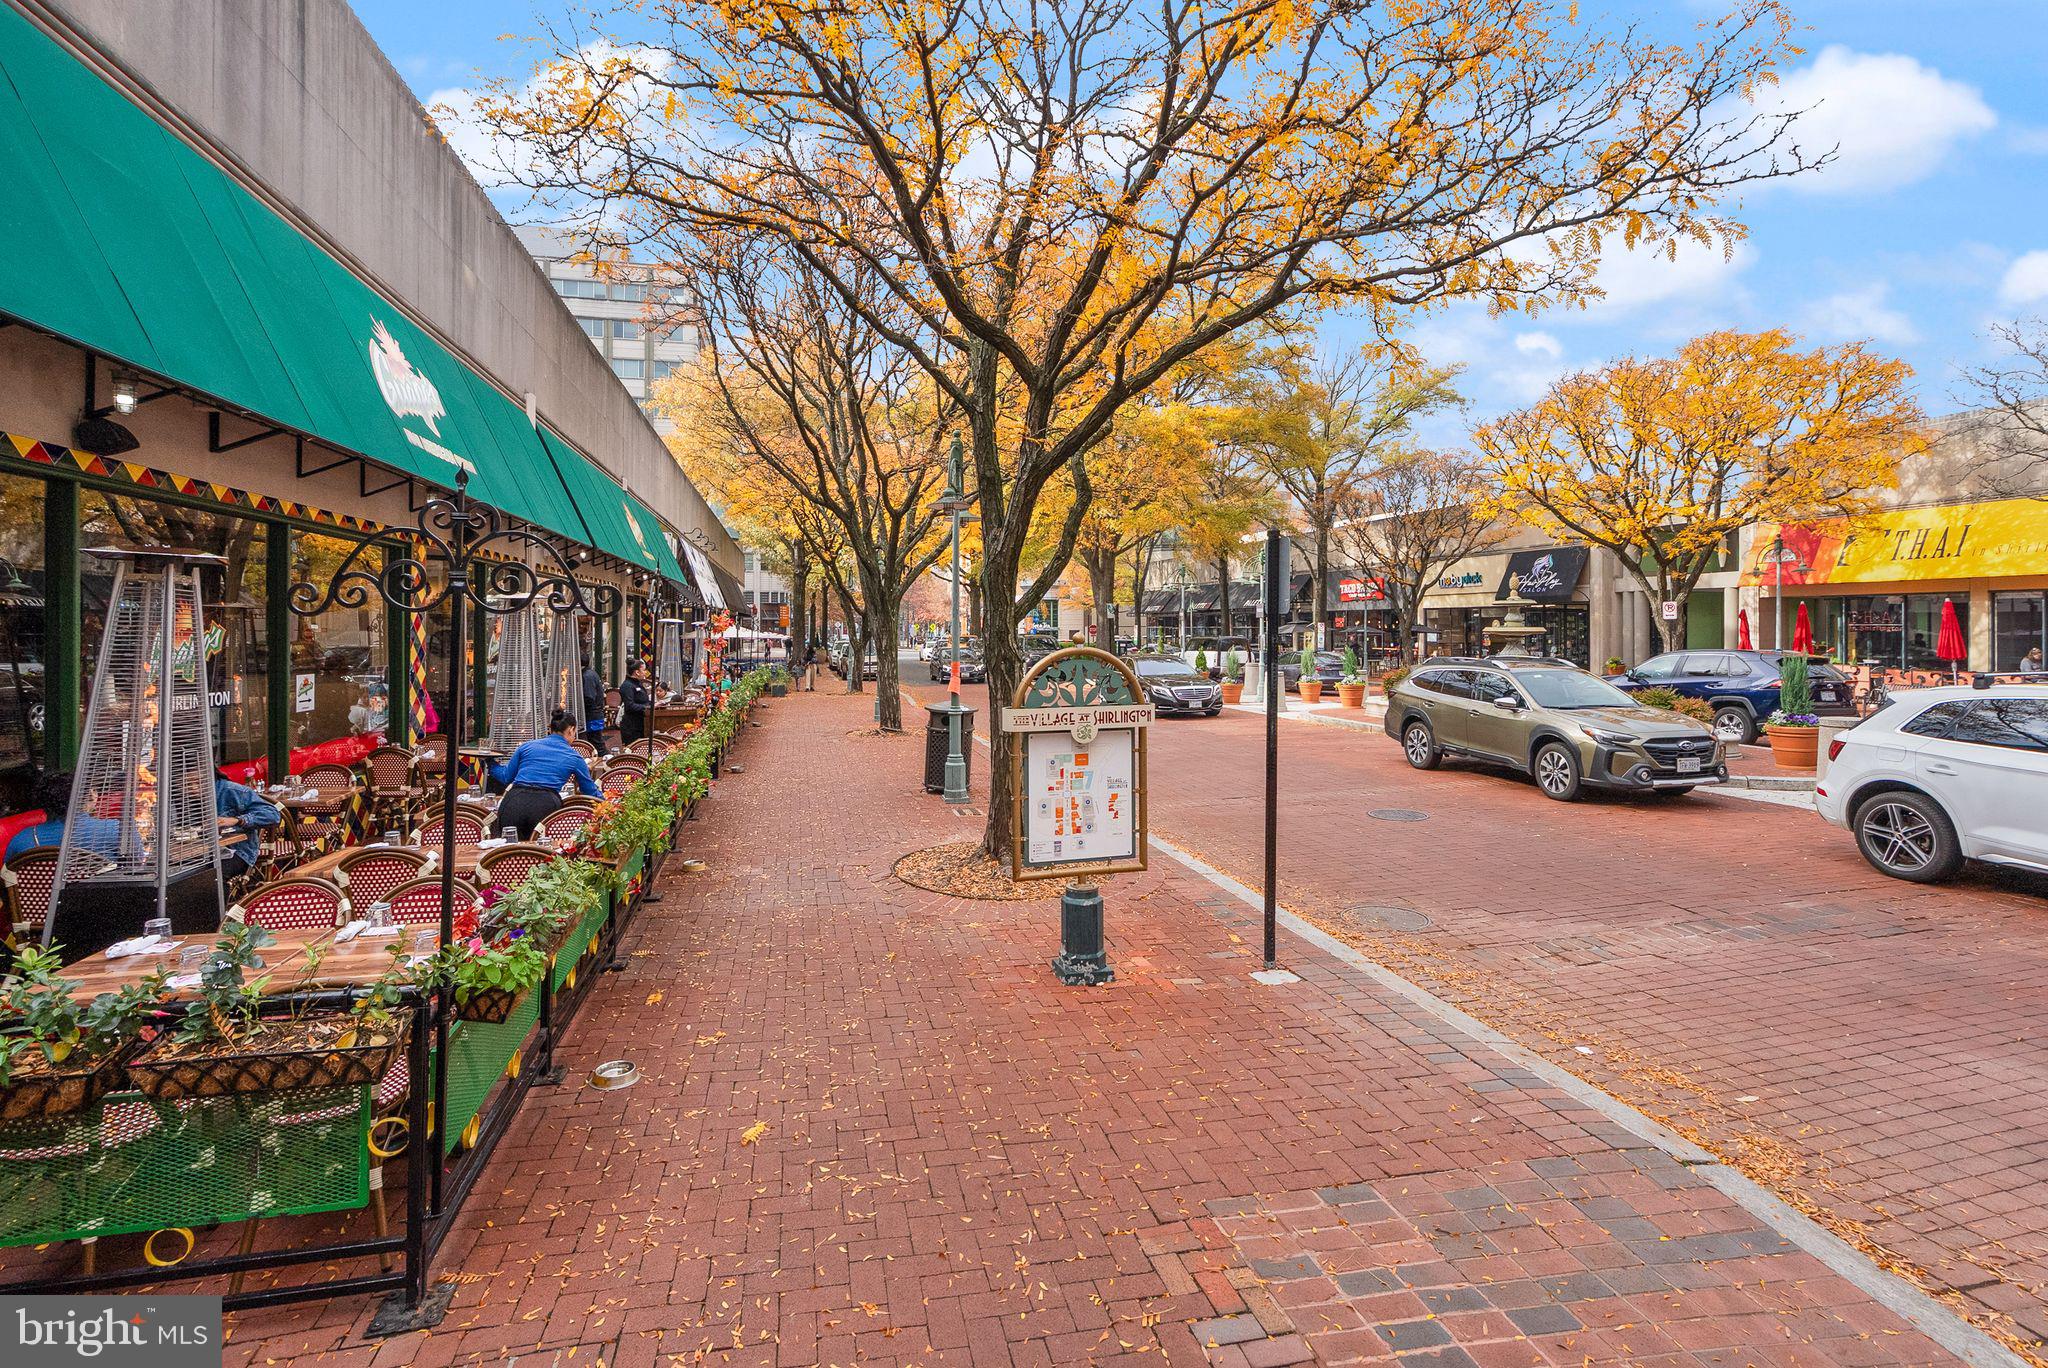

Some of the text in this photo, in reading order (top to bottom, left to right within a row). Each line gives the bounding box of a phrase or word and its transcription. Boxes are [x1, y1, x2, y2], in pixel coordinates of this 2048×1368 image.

[1030, 713, 1076, 727] VILLAGE
[1079, 714, 1090, 722] AT
[1093, 709, 1152, 726] SHIRLINGTON
